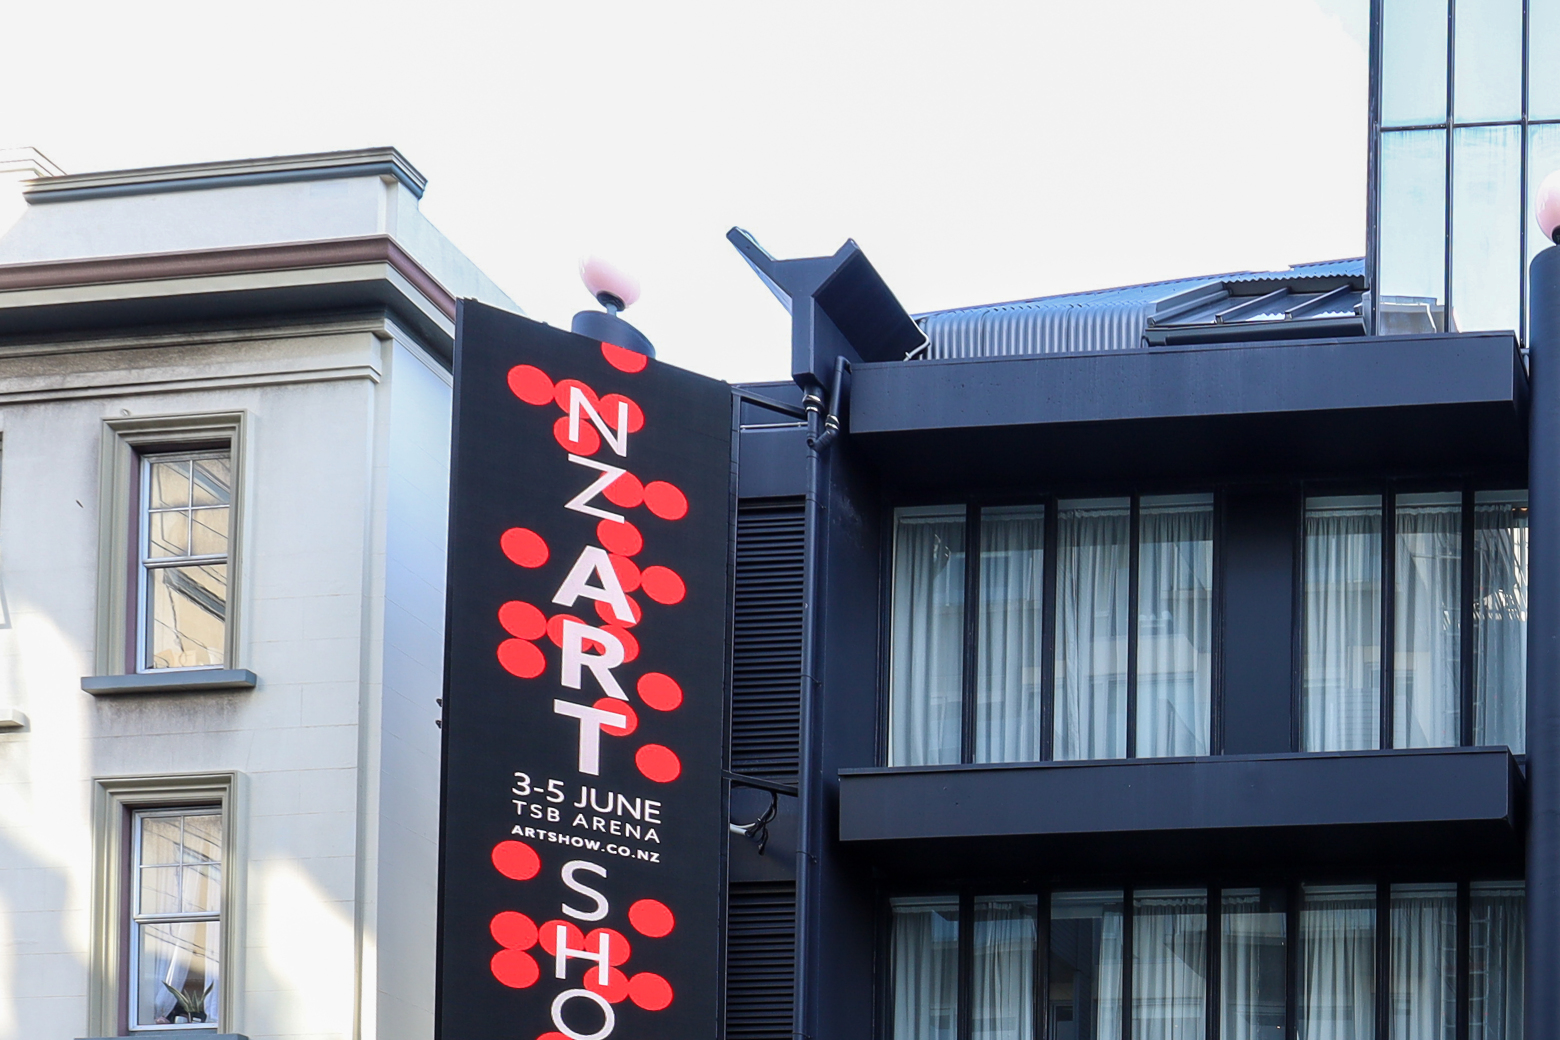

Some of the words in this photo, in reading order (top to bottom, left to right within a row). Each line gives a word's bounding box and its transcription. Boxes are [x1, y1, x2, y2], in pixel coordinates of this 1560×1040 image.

[511, 771, 565, 803] 3-5
[574, 786, 662, 824] JUNE
[511, 824, 661, 863] ARTSHOW.CO.NZ
[512, 800, 560, 822] TSB
[572, 813, 661, 844] ARENA
